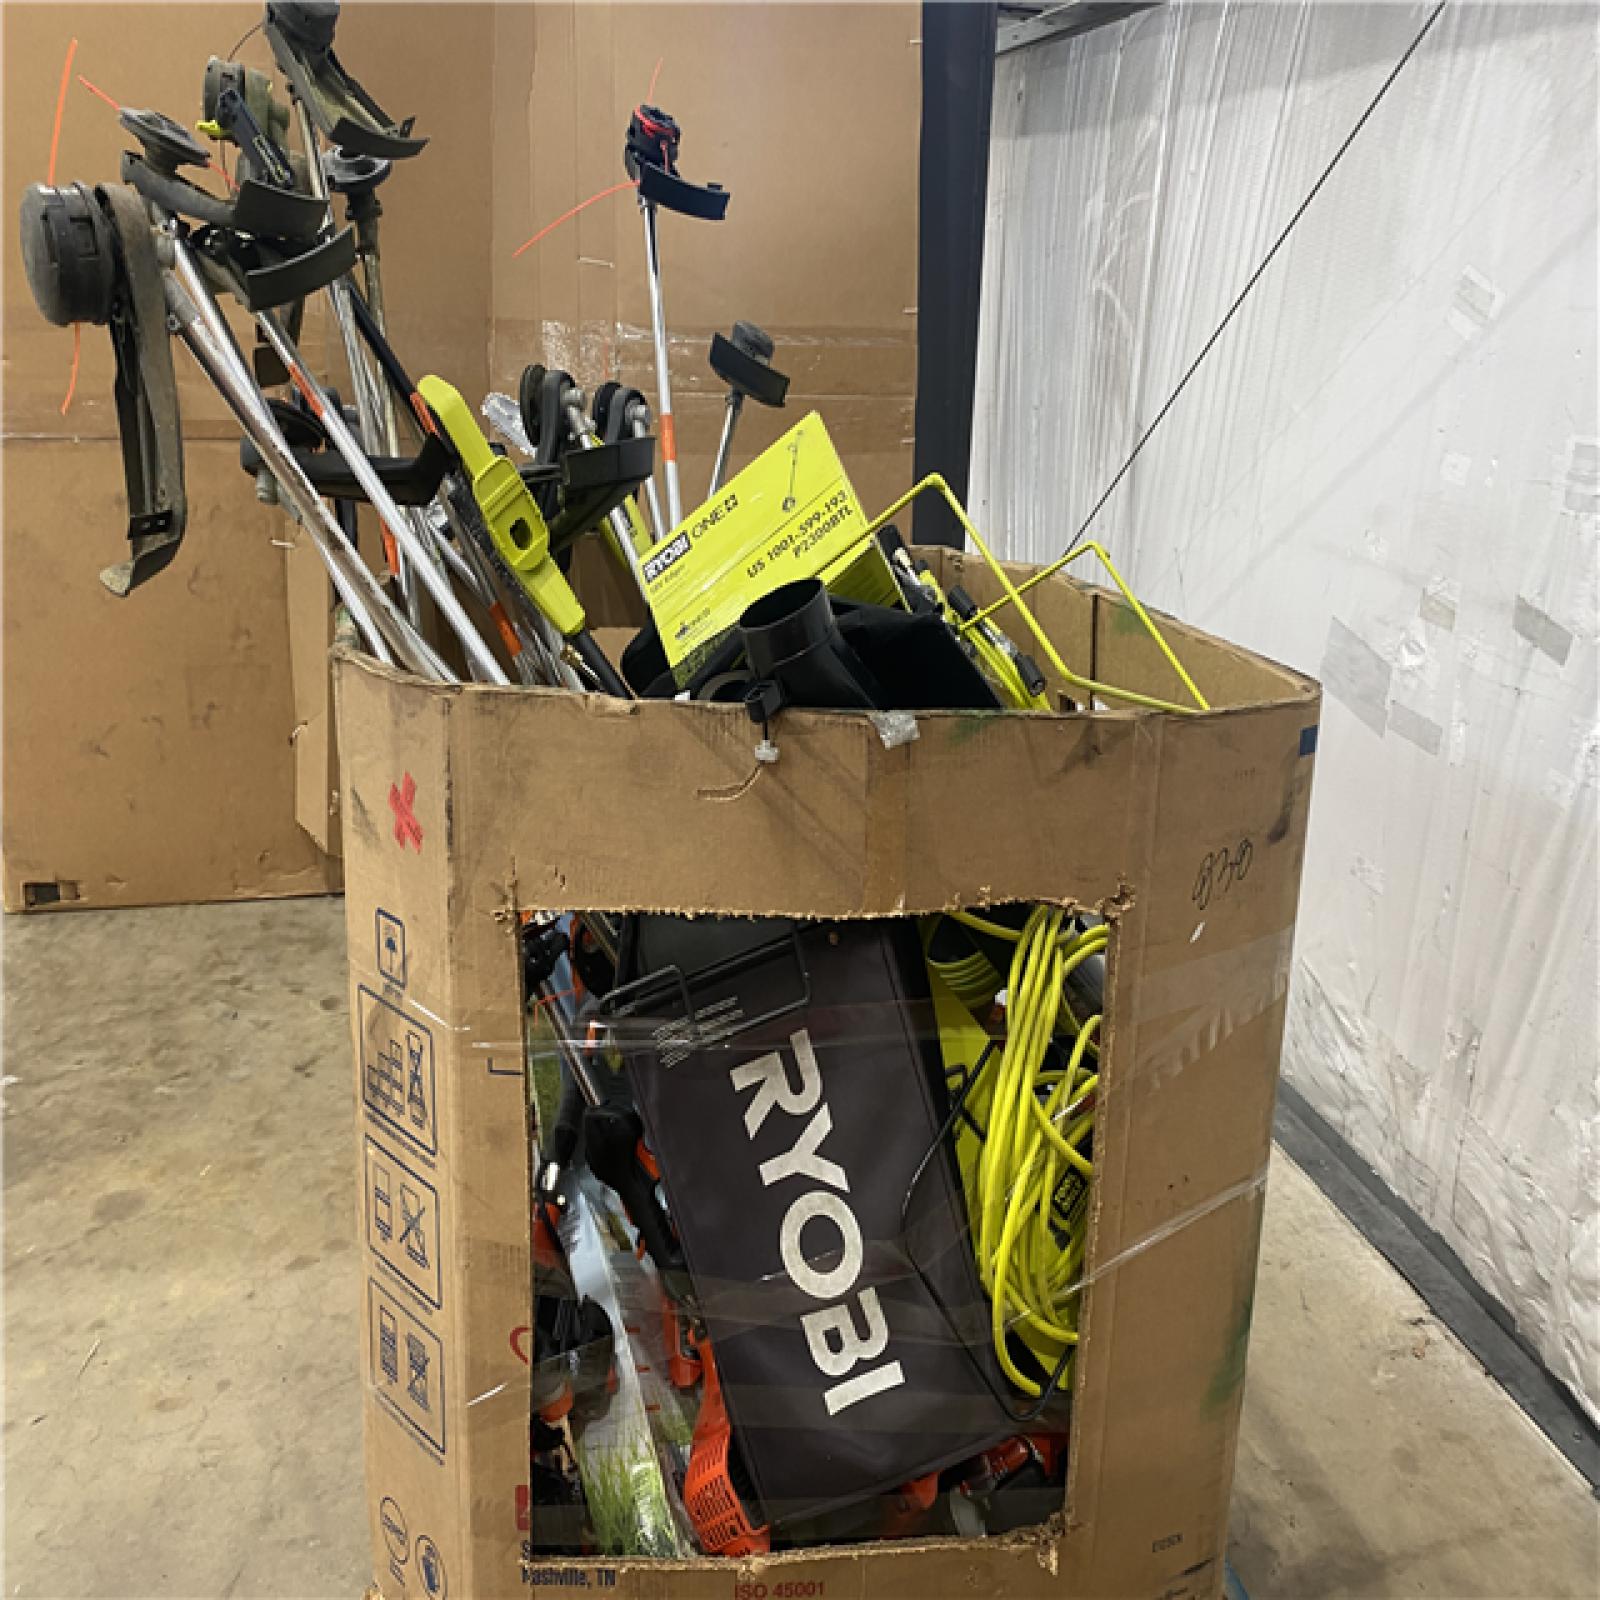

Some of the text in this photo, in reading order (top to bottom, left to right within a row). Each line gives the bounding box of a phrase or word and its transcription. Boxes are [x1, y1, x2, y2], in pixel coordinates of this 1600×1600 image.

[643, 531, 691, 583] RYOBI
[747, 558, 766, 578] US
[729, 1028, 906, 1417] RYOBI
[597, 1568, 616, 1586] TN
[734, 1581, 824, 1600] ISO 45001
